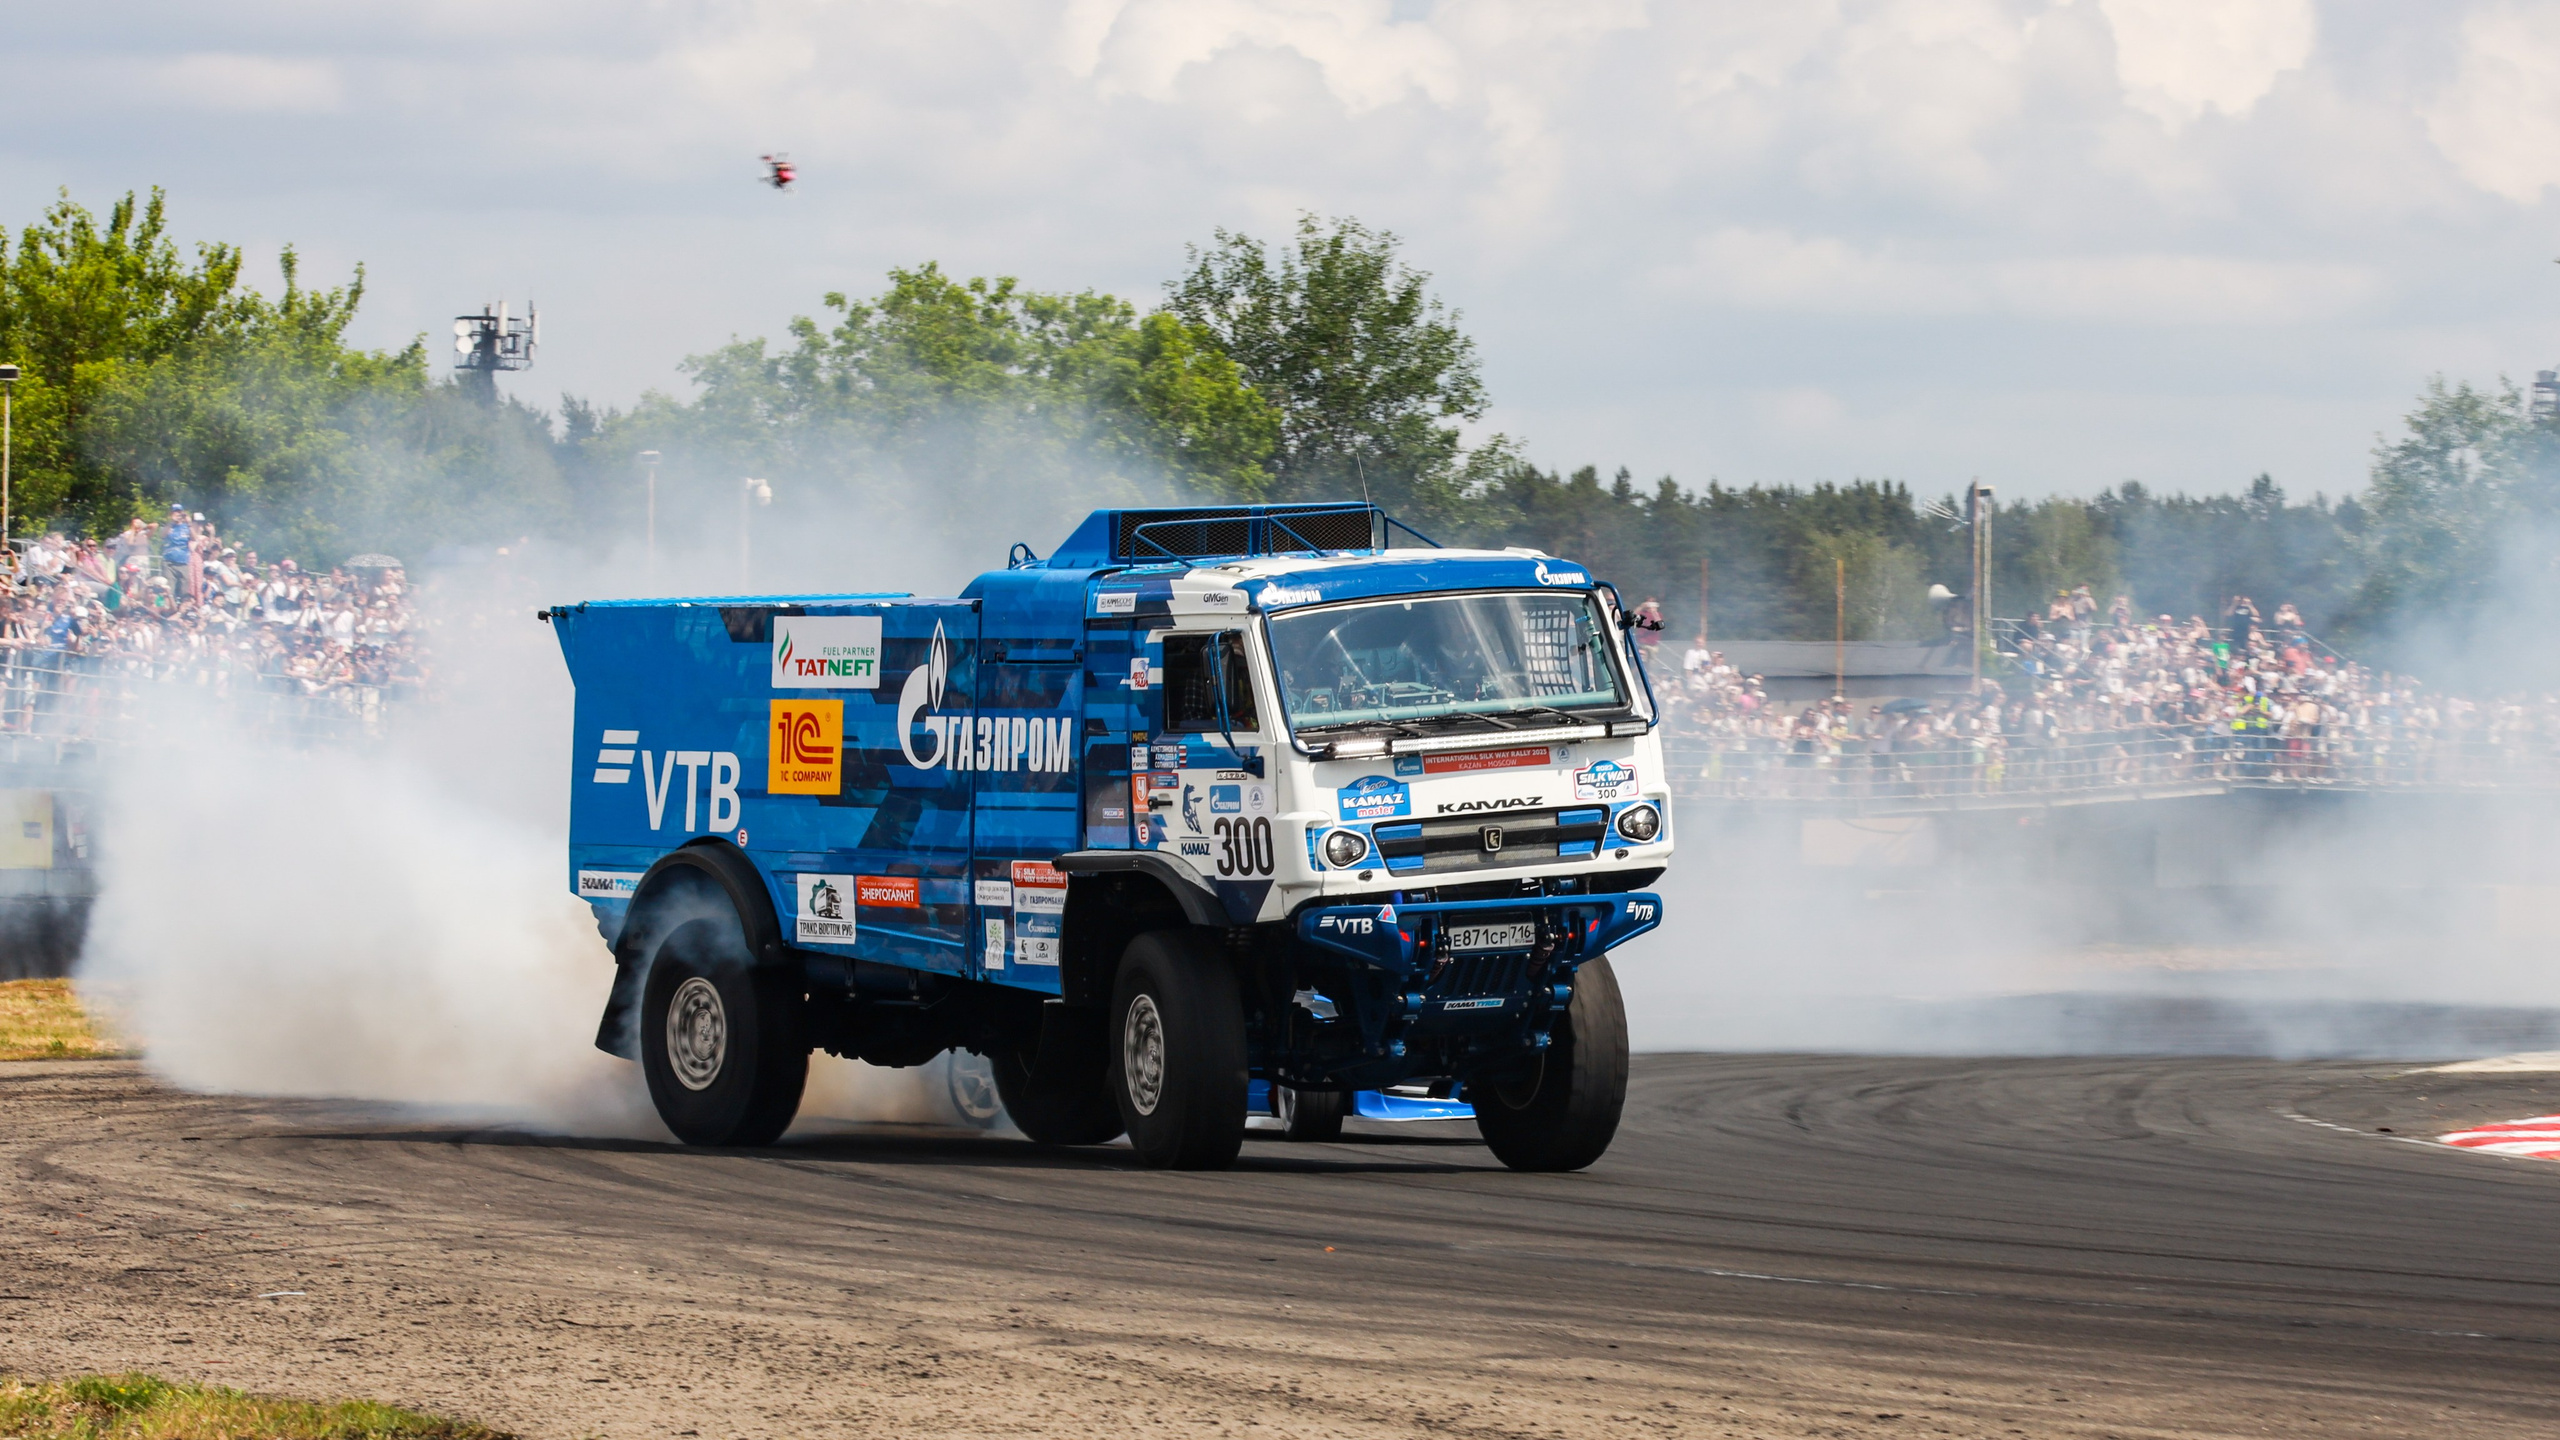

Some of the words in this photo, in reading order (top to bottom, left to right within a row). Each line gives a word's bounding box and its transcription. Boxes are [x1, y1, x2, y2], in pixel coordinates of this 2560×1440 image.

[823, 647, 841, 656] FUEL
[843, 647, 876, 656] PARTNER
[795, 659, 875, 677] TATNEFT
[946, 715, 1073, 773] ГАЗПРОМ
[1425, 752, 1478, 764] INTERNATIONAL
[1479, 752, 1494, 760] SILK
[1495, 751, 1510, 759] WAY
[1511, 749, 1532, 757] RALLY
[1532, 748, 1548, 756] 2023
[1458, 762, 1482, 770] KAZAN
[1488, 759, 1517, 768] MOSCOW
[792, 771, 833, 782] COMPANY
[1579, 771, 1608, 785] SILK
[1608, 769, 1632, 781] WAY
[641, 750, 741, 833] VTB
[1597, 788, 1618, 799] 300
[1342, 792, 1405, 809] KAMAZ
[1437, 796, 1544, 814] KAMAZ
[1357, 805, 1395, 818] master
[1180, 843, 1211, 856] KAMAZ
[1213, 815, 1275, 877] 300
[861, 888, 915, 902] ЭНЕРГОГАРАНТ
[1634, 904, 1654, 921] VTB
[800, 921, 818, 935] ТРАКС
[818, 922, 841, 936] ВОСТОК
[841, 923, 854, 937] РУС
[1336, 917, 1374, 934] VTB
[1510, 925, 1531, 940] 716
